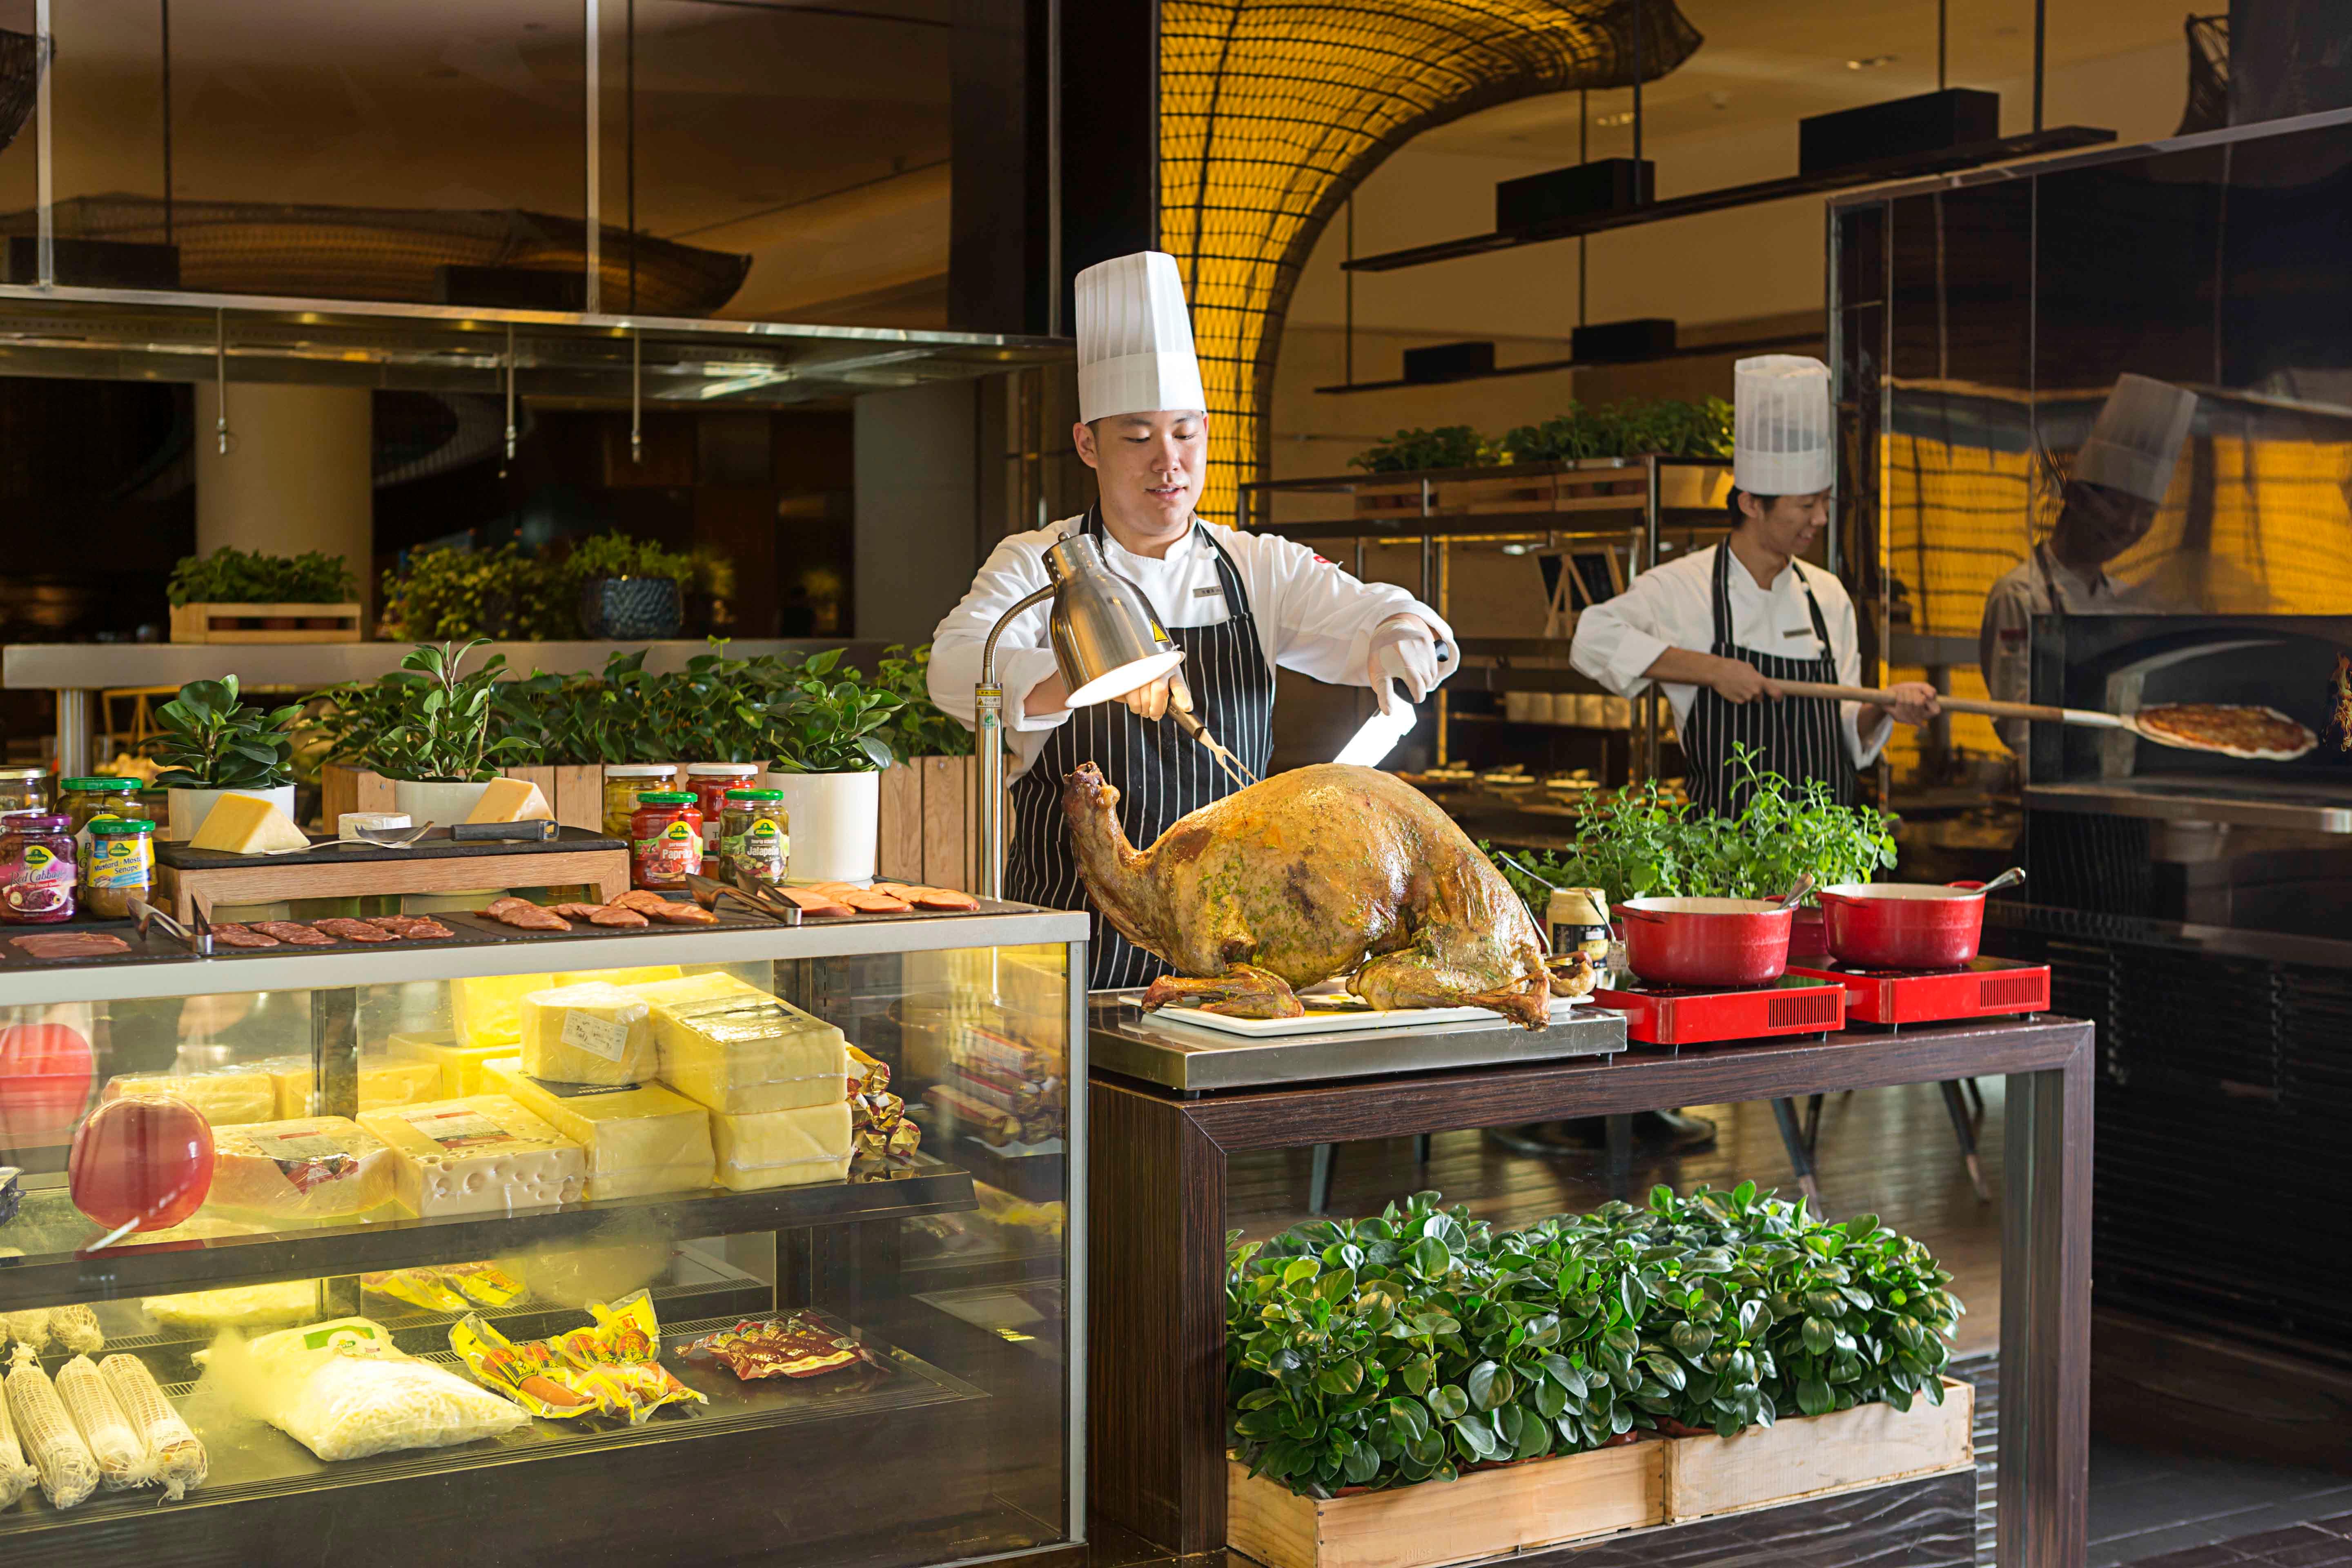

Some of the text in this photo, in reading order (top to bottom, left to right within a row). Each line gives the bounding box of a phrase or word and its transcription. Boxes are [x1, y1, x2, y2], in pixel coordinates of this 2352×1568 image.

[94, 860, 118, 872] Mustard
[114, 864, 138, 874] Senape
[9, 871, 28, 886] Red
